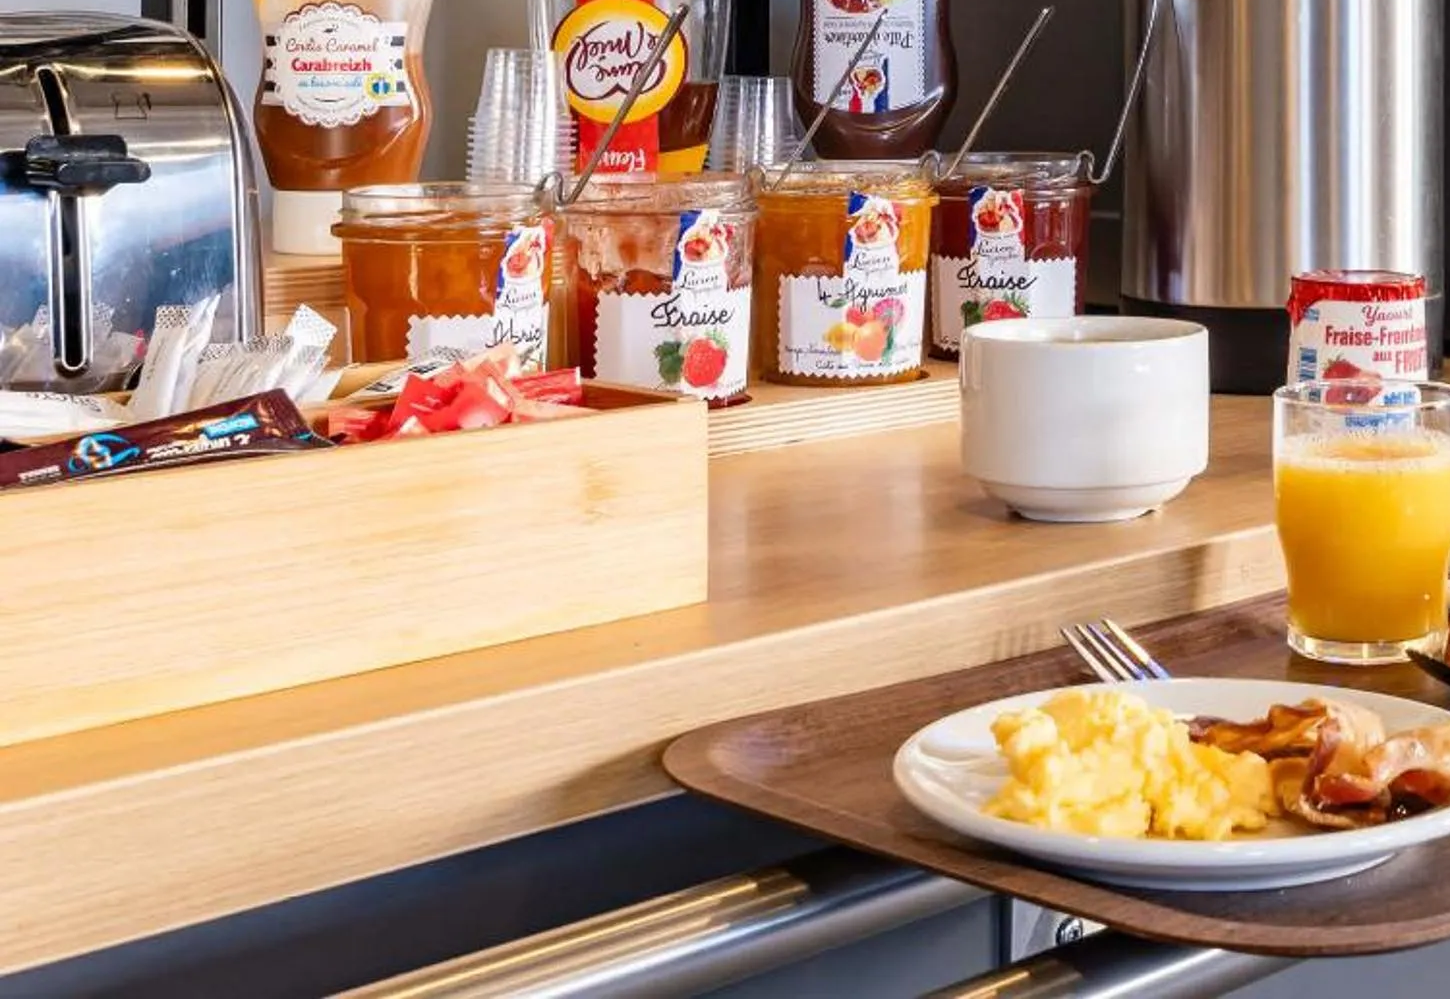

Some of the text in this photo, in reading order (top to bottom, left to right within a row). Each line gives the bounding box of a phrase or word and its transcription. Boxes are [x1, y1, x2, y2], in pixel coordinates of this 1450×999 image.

[291, 56, 373, 73] Carabreizh
[956, 259, 1038, 291] Fraise
[650, 292, 737, 329] Fraise
